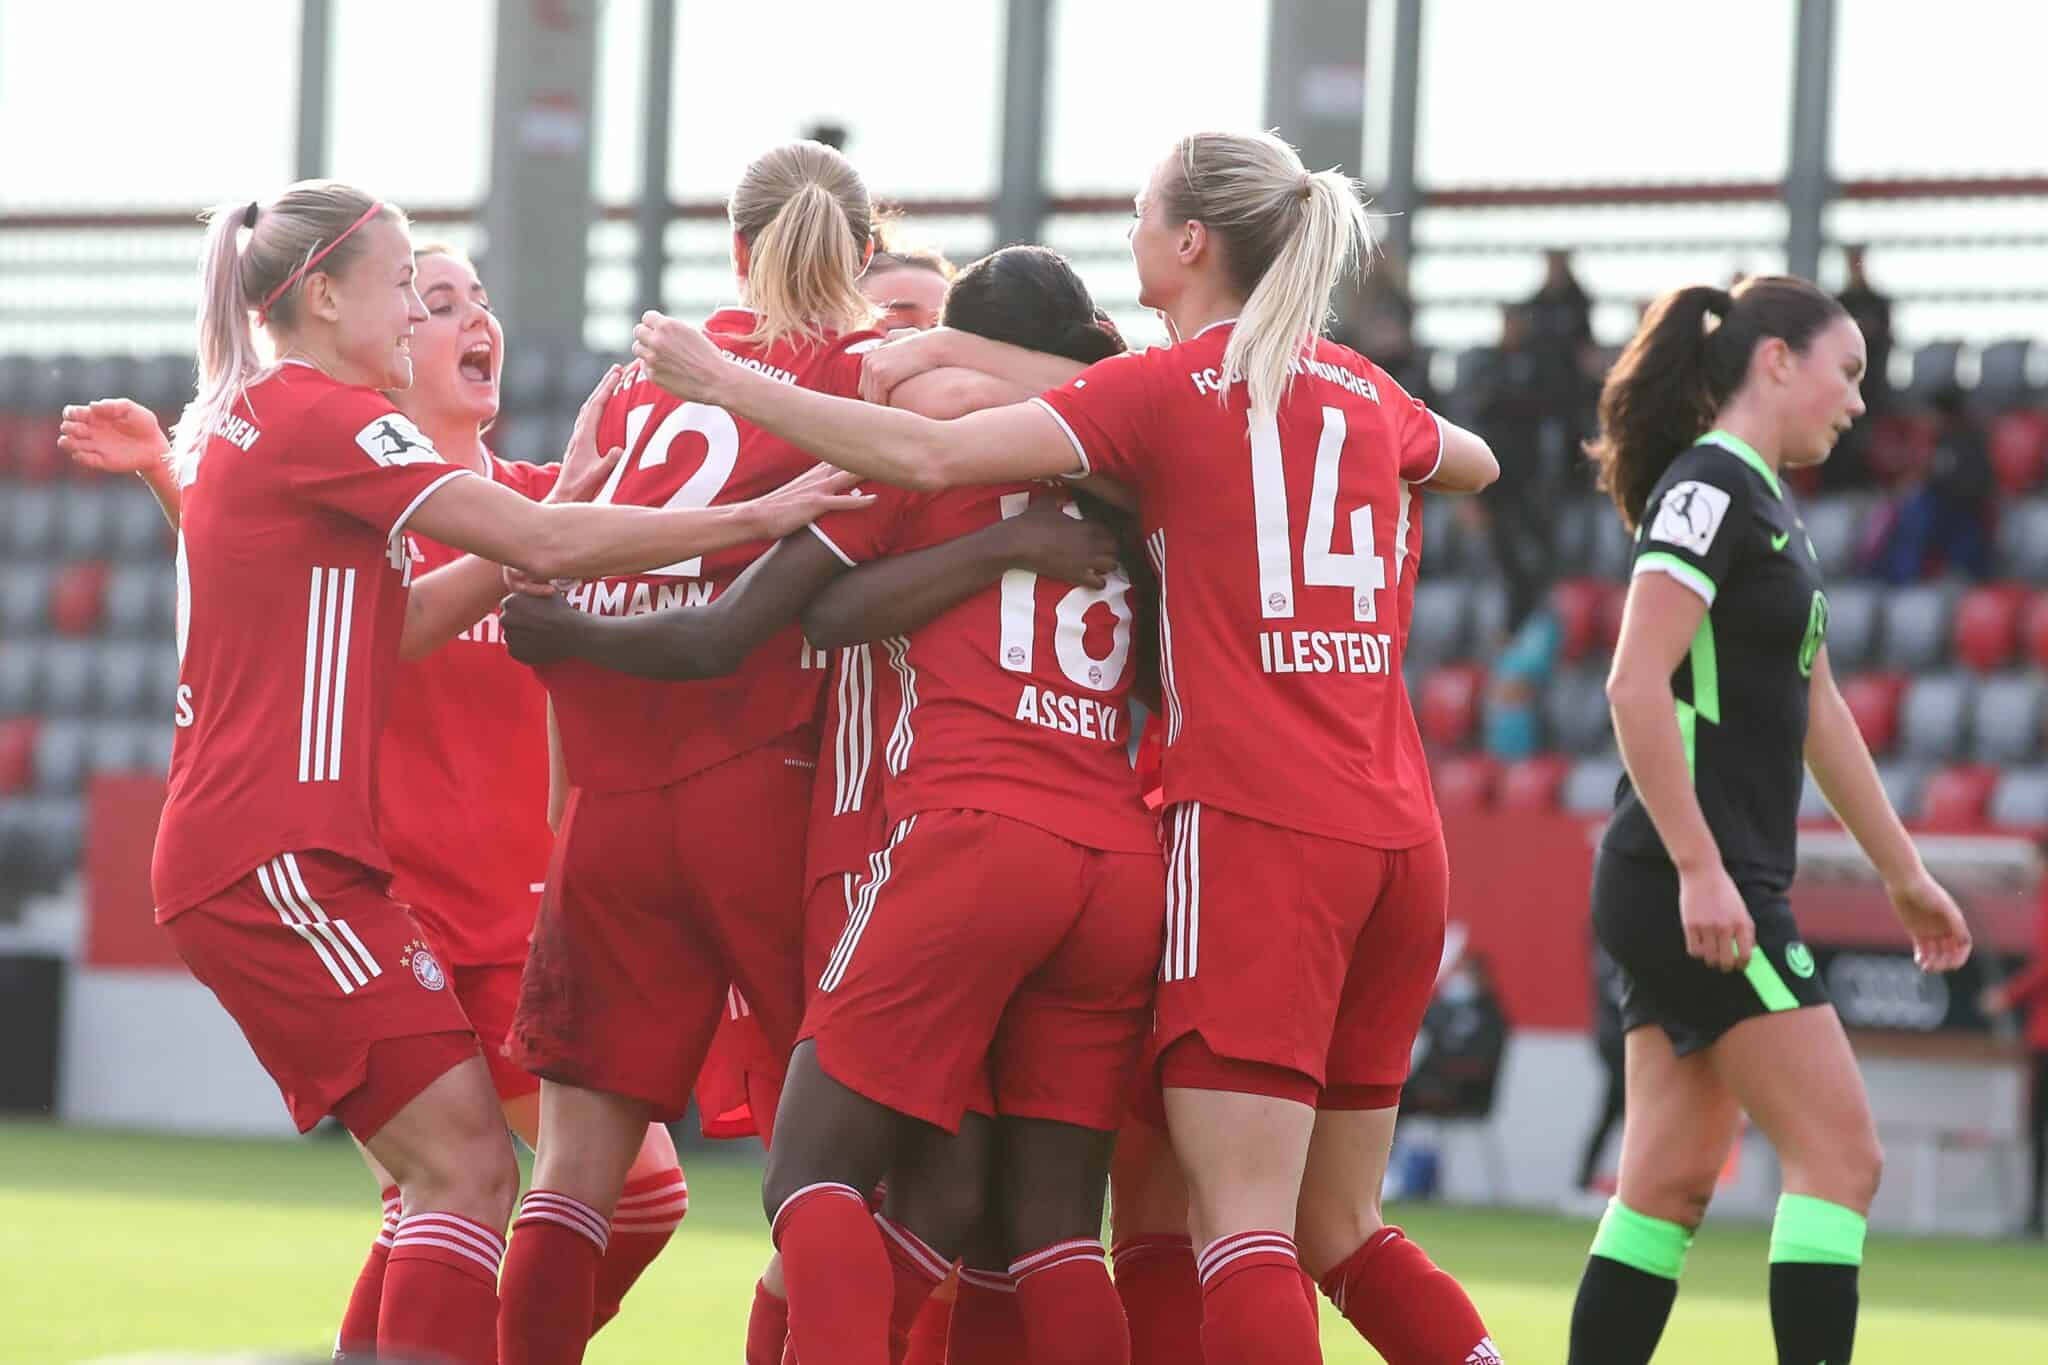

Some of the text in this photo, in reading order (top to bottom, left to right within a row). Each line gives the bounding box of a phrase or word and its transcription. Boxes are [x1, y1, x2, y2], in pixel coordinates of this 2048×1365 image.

[1191, 367, 1223, 396] FC
[217, 414, 261, 453] CHEN
[1246, 405, 1386, 622] 14
[566, 580, 715, 618] HMANN
[1258, 630, 1392, 677] ILESTEDT
[1015, 684, 1119, 743] ASSEYI
